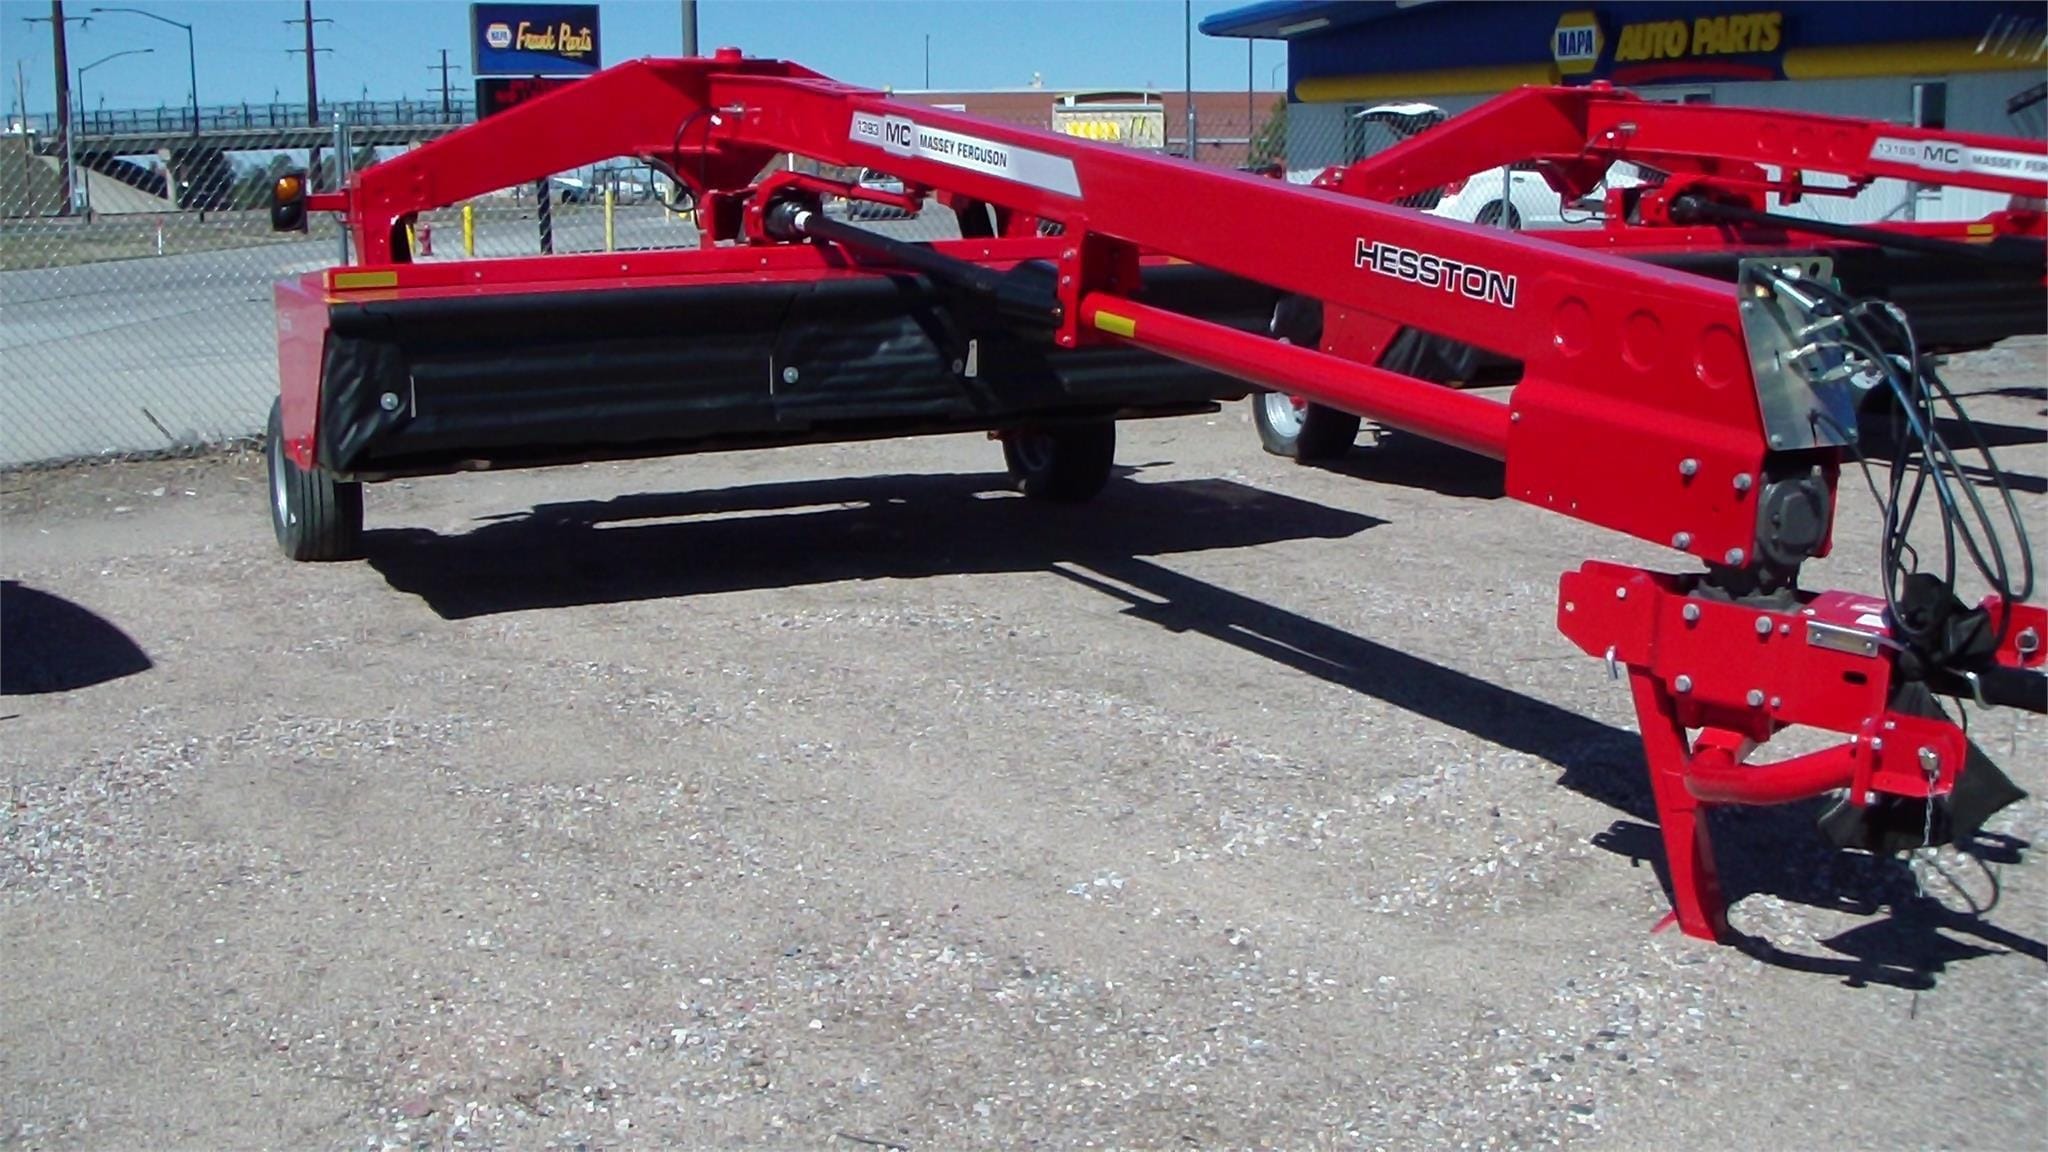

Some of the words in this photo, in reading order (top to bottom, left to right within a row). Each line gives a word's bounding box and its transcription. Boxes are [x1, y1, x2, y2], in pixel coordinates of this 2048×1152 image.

[1557, 29, 1594, 57] NAPA
[1614, 20, 1689, 62] AUTO
[1691, 12, 1782, 56] PARTS
[857, 119, 880, 137] 1393
[885, 121, 912, 147] MC
[919, 133, 956, 155] MASSEY
[956, 142, 1009, 168] FERGUSON
[1922, 145, 1960, 164] MC
[1971, 154, 2022, 170] MASSEY
[1354, 236, 1518, 309] HESSTON
